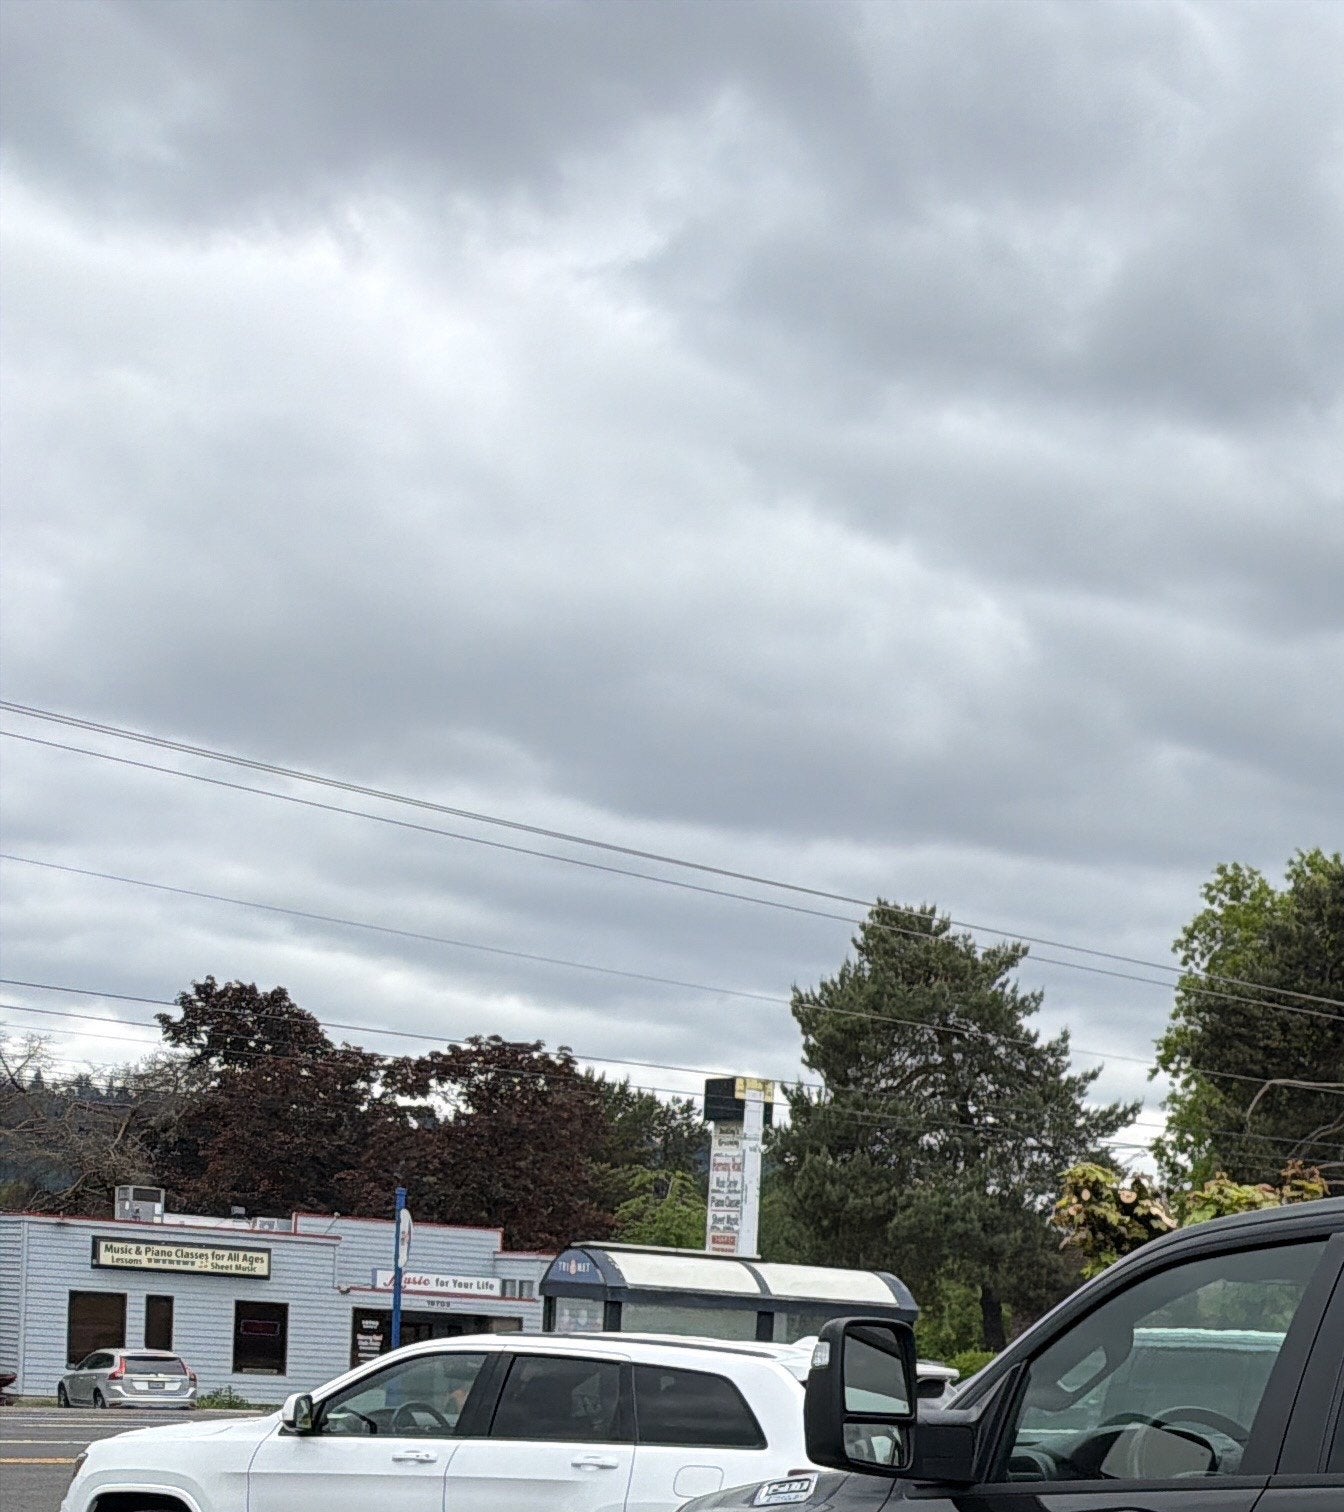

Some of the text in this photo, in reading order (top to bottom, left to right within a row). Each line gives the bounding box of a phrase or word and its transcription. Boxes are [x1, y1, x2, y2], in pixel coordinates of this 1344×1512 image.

[104, 1243, 264, 1265] Music & Piano Classes for All Ages
[111, 1254, 142, 1265] Lessons
[210, 1262, 258, 1272] Sheet Music
[435, 1278, 449, 1288] for
[452, 1279, 473, 1289] Your
[476, 1280, 495, 1291] Life
